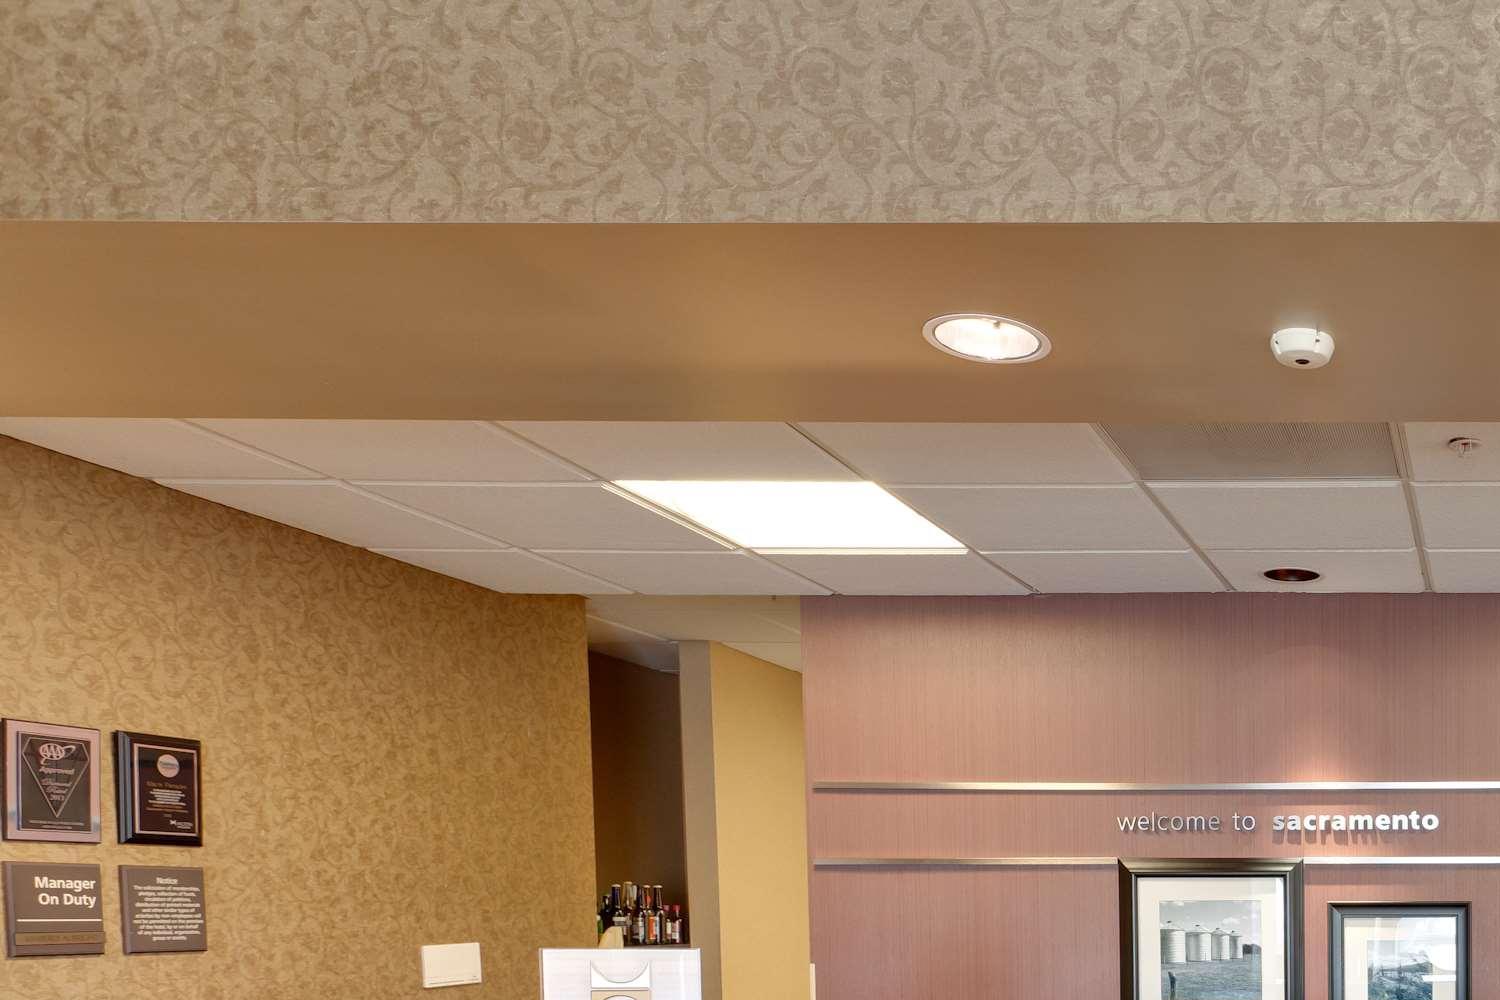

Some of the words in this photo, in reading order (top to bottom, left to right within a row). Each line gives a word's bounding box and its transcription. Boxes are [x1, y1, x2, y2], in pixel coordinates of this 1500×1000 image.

[1116, 811, 1221, 832] welcome
[1232, 814, 1256, 832] to
[1271, 810, 1439, 832] sacramento
[34, 876, 96, 892] Manager
[38, 893, 60, 905] On
[63, 893, 97, 908] Duty
